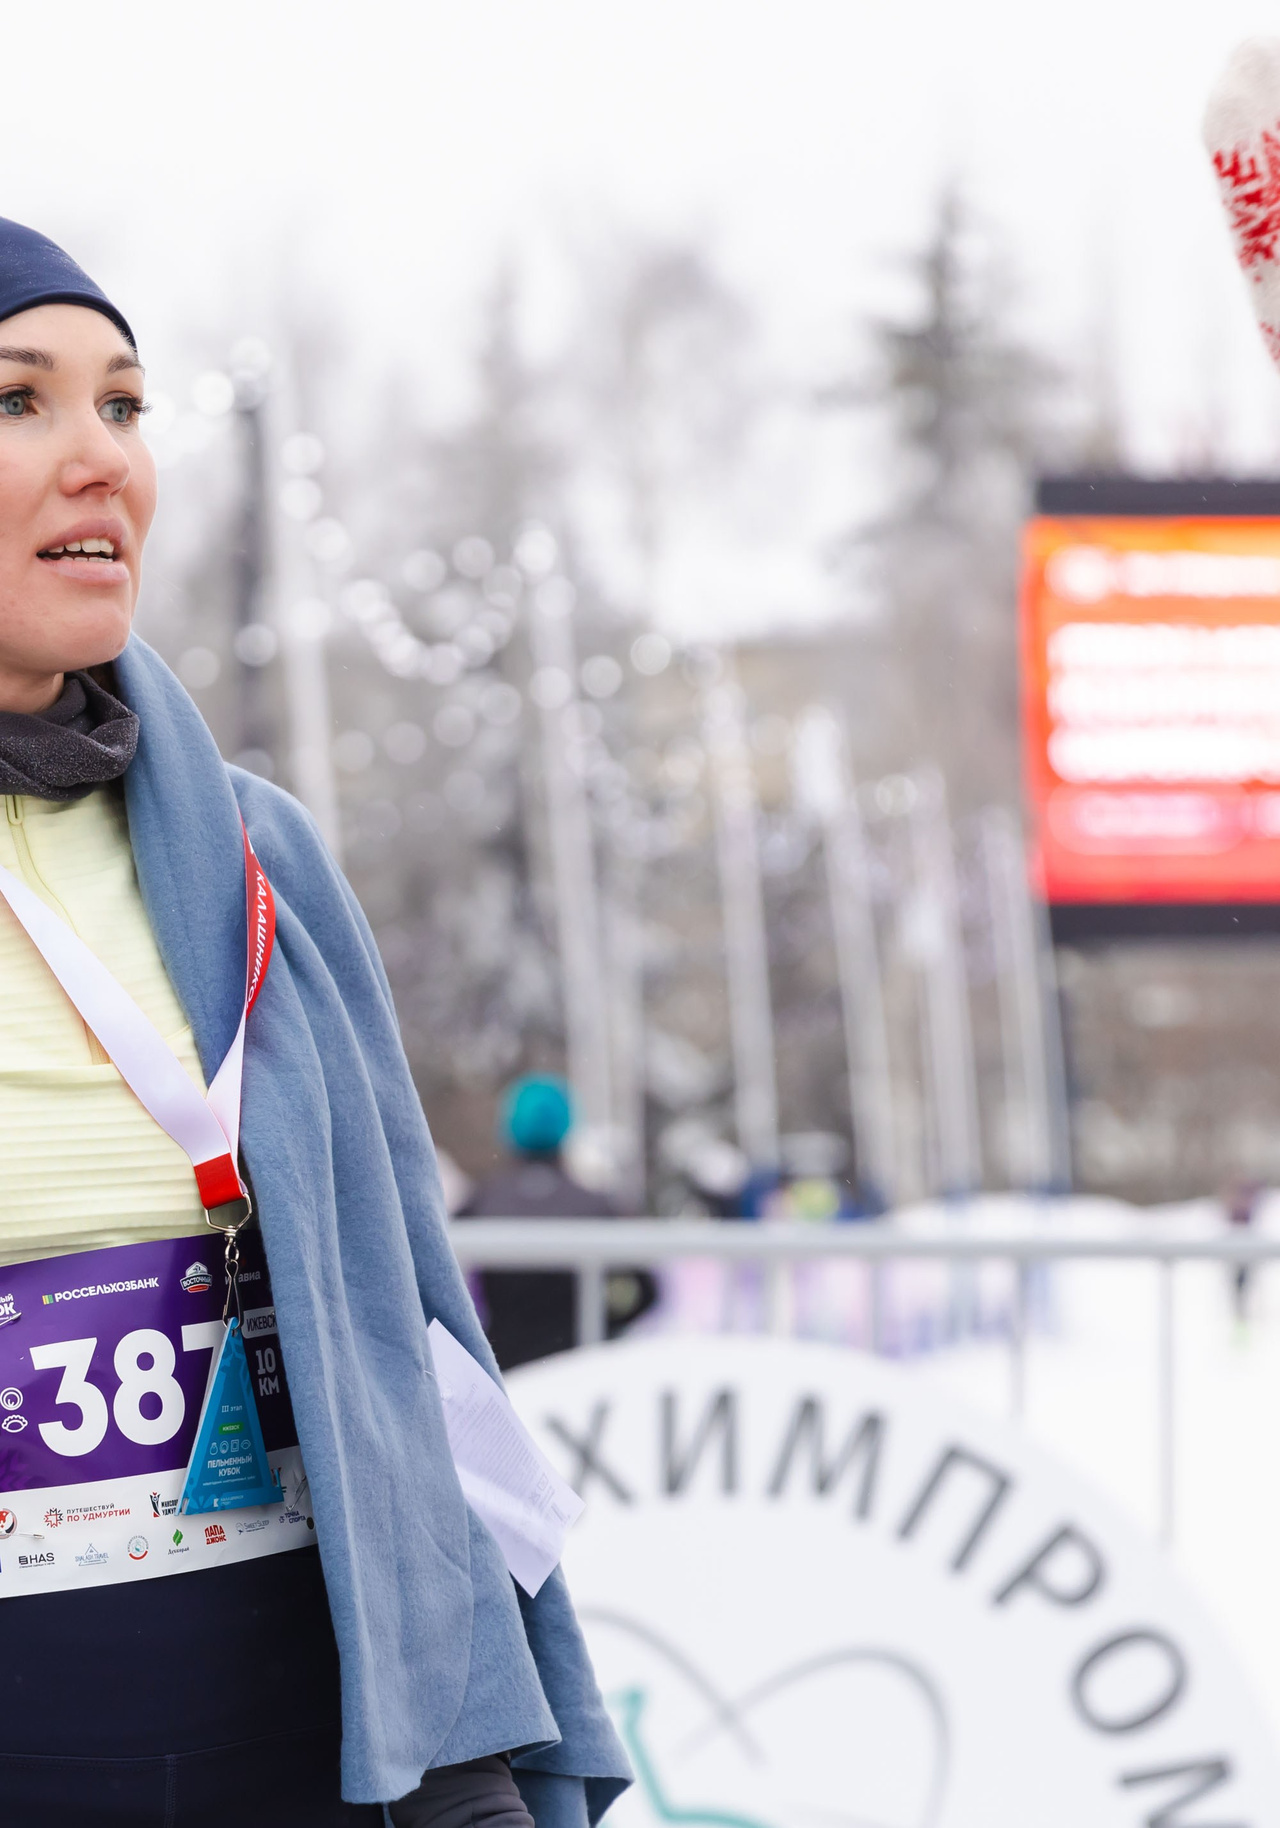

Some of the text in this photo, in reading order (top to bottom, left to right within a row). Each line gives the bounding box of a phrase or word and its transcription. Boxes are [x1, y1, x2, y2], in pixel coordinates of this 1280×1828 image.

[54, 1277, 159, 1302] РОССЕЛЬХОЗБАНК
[255, 1347, 276, 1375] 10
[207, 1453, 253, 1469] ПЕЛЬМЕННЫЙ
[218, 1467, 241, 1477] КУБОК
[66, 1503, 115, 1514] ПУТЕШЕСТВУЙ
[82, 1508, 131, 1521] УДМУРТИИ
[204, 1524, 225, 1537] ПАПА
[206, 1535, 227, 1545] ДЖОНС
[29, 1552, 55, 1564] HAS
